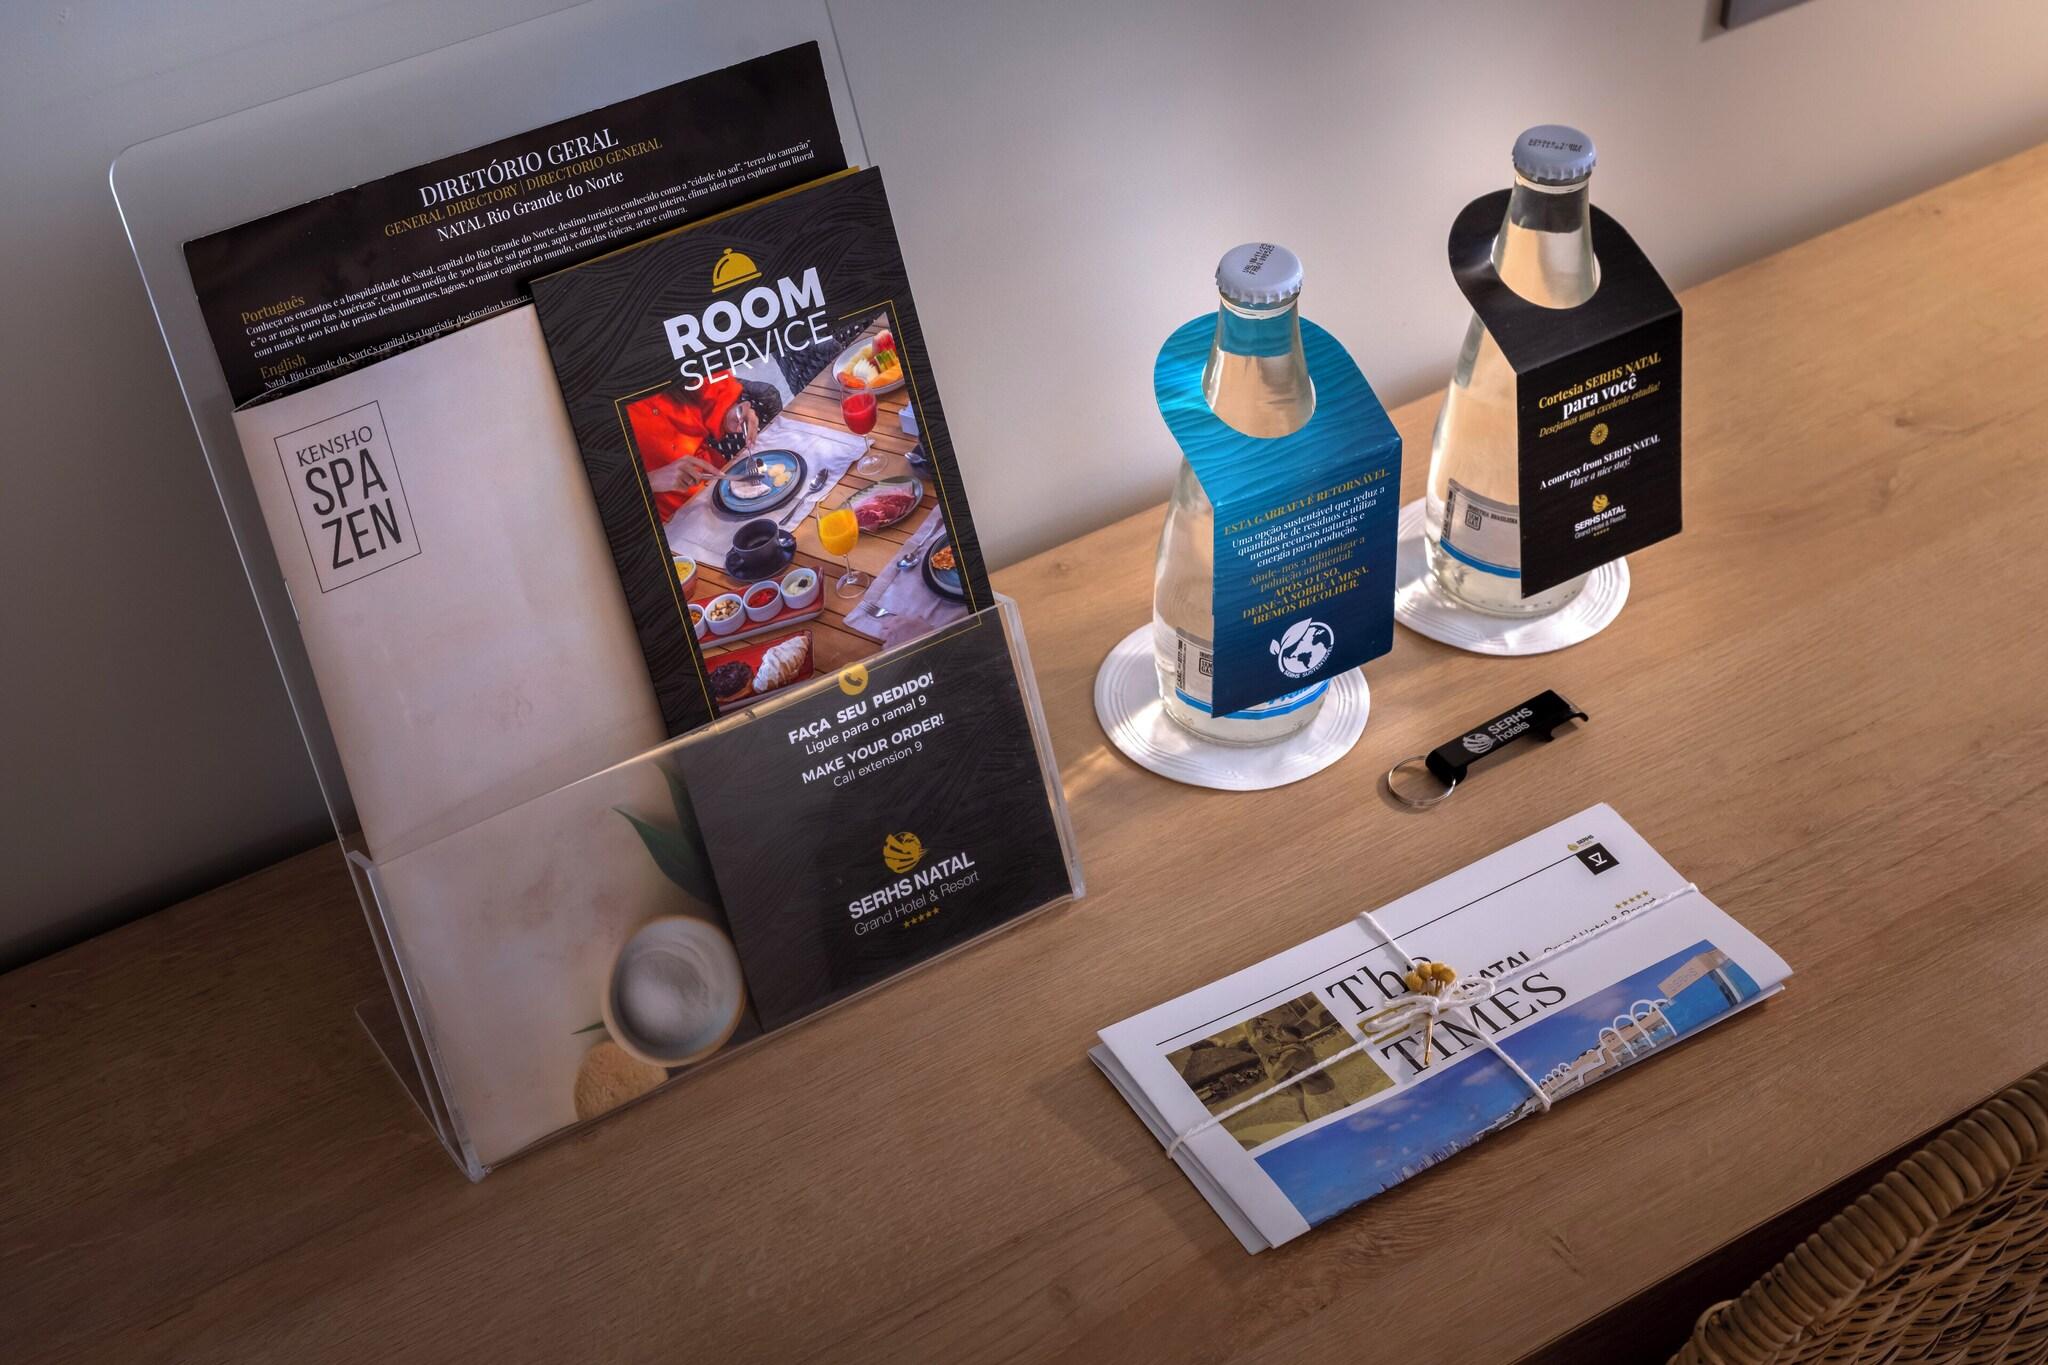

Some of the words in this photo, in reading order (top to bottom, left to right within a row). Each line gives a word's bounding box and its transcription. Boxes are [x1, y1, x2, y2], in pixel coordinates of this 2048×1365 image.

[385, 209, 445, 236] GENERAL
[446, 183, 517, 216] DIRECTORY
[526, 156, 603, 190] DIRECTORIO
[606, 138, 662, 164] GENERAL
[419, 152, 542, 207] DIRETÓRIO
[548, 128, 619, 164] GERAL
[437, 216, 486, 241] NATAL
[486, 208, 510, 225] Rio
[513, 190, 563, 216] Grande
[566, 184, 583, 199] do
[585, 172, 623, 192] Norte
[246, 313, 283, 335] Conheça
[295, 303, 332, 319] encantos
[345, 278, 399, 303] hospitalidade
[437, 256, 464, 272] capital
[476, 249, 490, 258] Rio
[491, 238, 520, 253] Grande
[558, 217, 586, 231] destino
[587, 206, 620, 221] turístico
[620, 192, 659, 210] conhecido
[660, 185, 681, 197] como
[277, 325, 299, 337] mais
[300, 319, 321, 332] puro
[322, 313, 337, 323] das
[381, 291, 401, 302] Com
[402, 285, 421, 295] uma
[422, 275, 447, 289] média
[460, 267, 474, 277] 300
[476, 261, 492, 271] dias
[504, 250, 516, 261] sol
[517, 247, 531, 258] por
[551, 233, 568, 245] aqui
[579, 226, 592, 236] diz
[593, 222, 607, 232] que
[614, 211, 636, 223] verão
[643, 205, 658, 214] ano
[687, 188, 708, 199] clima
[709, 179, 727, 192] ideal
[728, 175, 746, 187] para
[746, 164, 777, 179] explorar
[791, 149, 814, 164] litoral
[241, 295, 305, 324] Português
[254, 347, 272, 358] com
[274, 339, 294, 351] mais
[307, 330, 323, 341] 400
[351, 312, 377, 327] praias
[475, 270, 499, 283] maior
[500, 257, 531, 275] cajueiro
[575, 231, 607, 249] comidas
[636, 218, 651, 229] arte
[663, 267, 826, 361] ROOM
[260, 354, 306, 379] English
[680, 310, 833, 391] SERVICE
[1538, 384, 1584, 409] Cortesia
[1585, 367, 1623, 391] SERHS
[1625, 352, 1662, 375] NATAL
[1563, 392, 1599, 420] para
[1602, 372, 1637, 400] você
[295, 425, 373, 468] KENSHO
[1539, 416, 1578, 438] Desejamos
[1579, 408, 1596, 421] uma
[305, 448, 388, 516] SPA
[1540, 480, 1547, 490] A
[1547, 466, 1582, 486] courtesy
[1582, 459, 1603, 472] from
[1603, 445, 1632, 464] SERHS
[1633, 434, 1661, 451] NATAL
[1570, 475, 1589, 489] Have
[1596, 465, 1613, 477] nice
[1613, 455, 1632, 470] stay!
[321, 498, 402, 570] ZEN
[1223, 519, 1252, 536] ESTA
[1254, 499, 1306, 524] GARRAFA
[1232, 536, 1252, 549] Uma
[1254, 526, 1282, 540] opção
[1283, 504, 1333, 529] sustentável
[1334, 499, 1352, 514] que
[1353, 490, 1378, 504] reduz
[1380, 486, 1385, 494] a
[1238, 532, 1289, 557] quantidade
[1290, 526, 1301, 537] de
[1303, 513, 1341, 532] resíduos
[1349, 499, 1377, 514] utiliza
[1250, 545, 1280, 561] menos
[1281, 530, 1320, 550] recursos
[1322, 515, 1358, 535] naturais
[1574, 514, 1601, 532] SERHS
[1601, 505, 1627, 520] NATAL
[1257, 549, 1291, 568] energia
[1292, 542, 1312, 556] para
[1309, 540, 1358, 563] minimizar
[1253, 604, 1297, 625] IREMOS
[1291, 581, 1327, 601] SOBRE
[788, 718, 832, 745] FAÇA
[836, 701, 868, 724] SEU
[872, 671, 935, 709] PEDIDO!
[805, 734, 840, 756] Ligue
[842, 723, 869, 742] para
[871, 717, 880, 727] o
[882, 699, 917, 723] ramal
[918, 694, 927, 706] 9
[1488, 707, 1533, 735] SERHS
[1495, 721, 1530, 742] hotels
[801, 756, 846, 784] MAKE
[847, 738, 889, 764] YOUR
[891, 713, 945, 745] ORDER!
[833, 769, 856, 787] Call
[858, 747, 913, 777] extension
[914, 741, 923, 752] 9
[848, 878, 913, 919] SERHS
[913, 852, 976, 890] NATAL
[854, 911, 893, 936] Grand
[895, 894, 927, 919] Hotel
[929, 889, 939, 903] &
[940, 870, 980, 897] Resort
[1380, 972, 1567, 1076] TIMES
